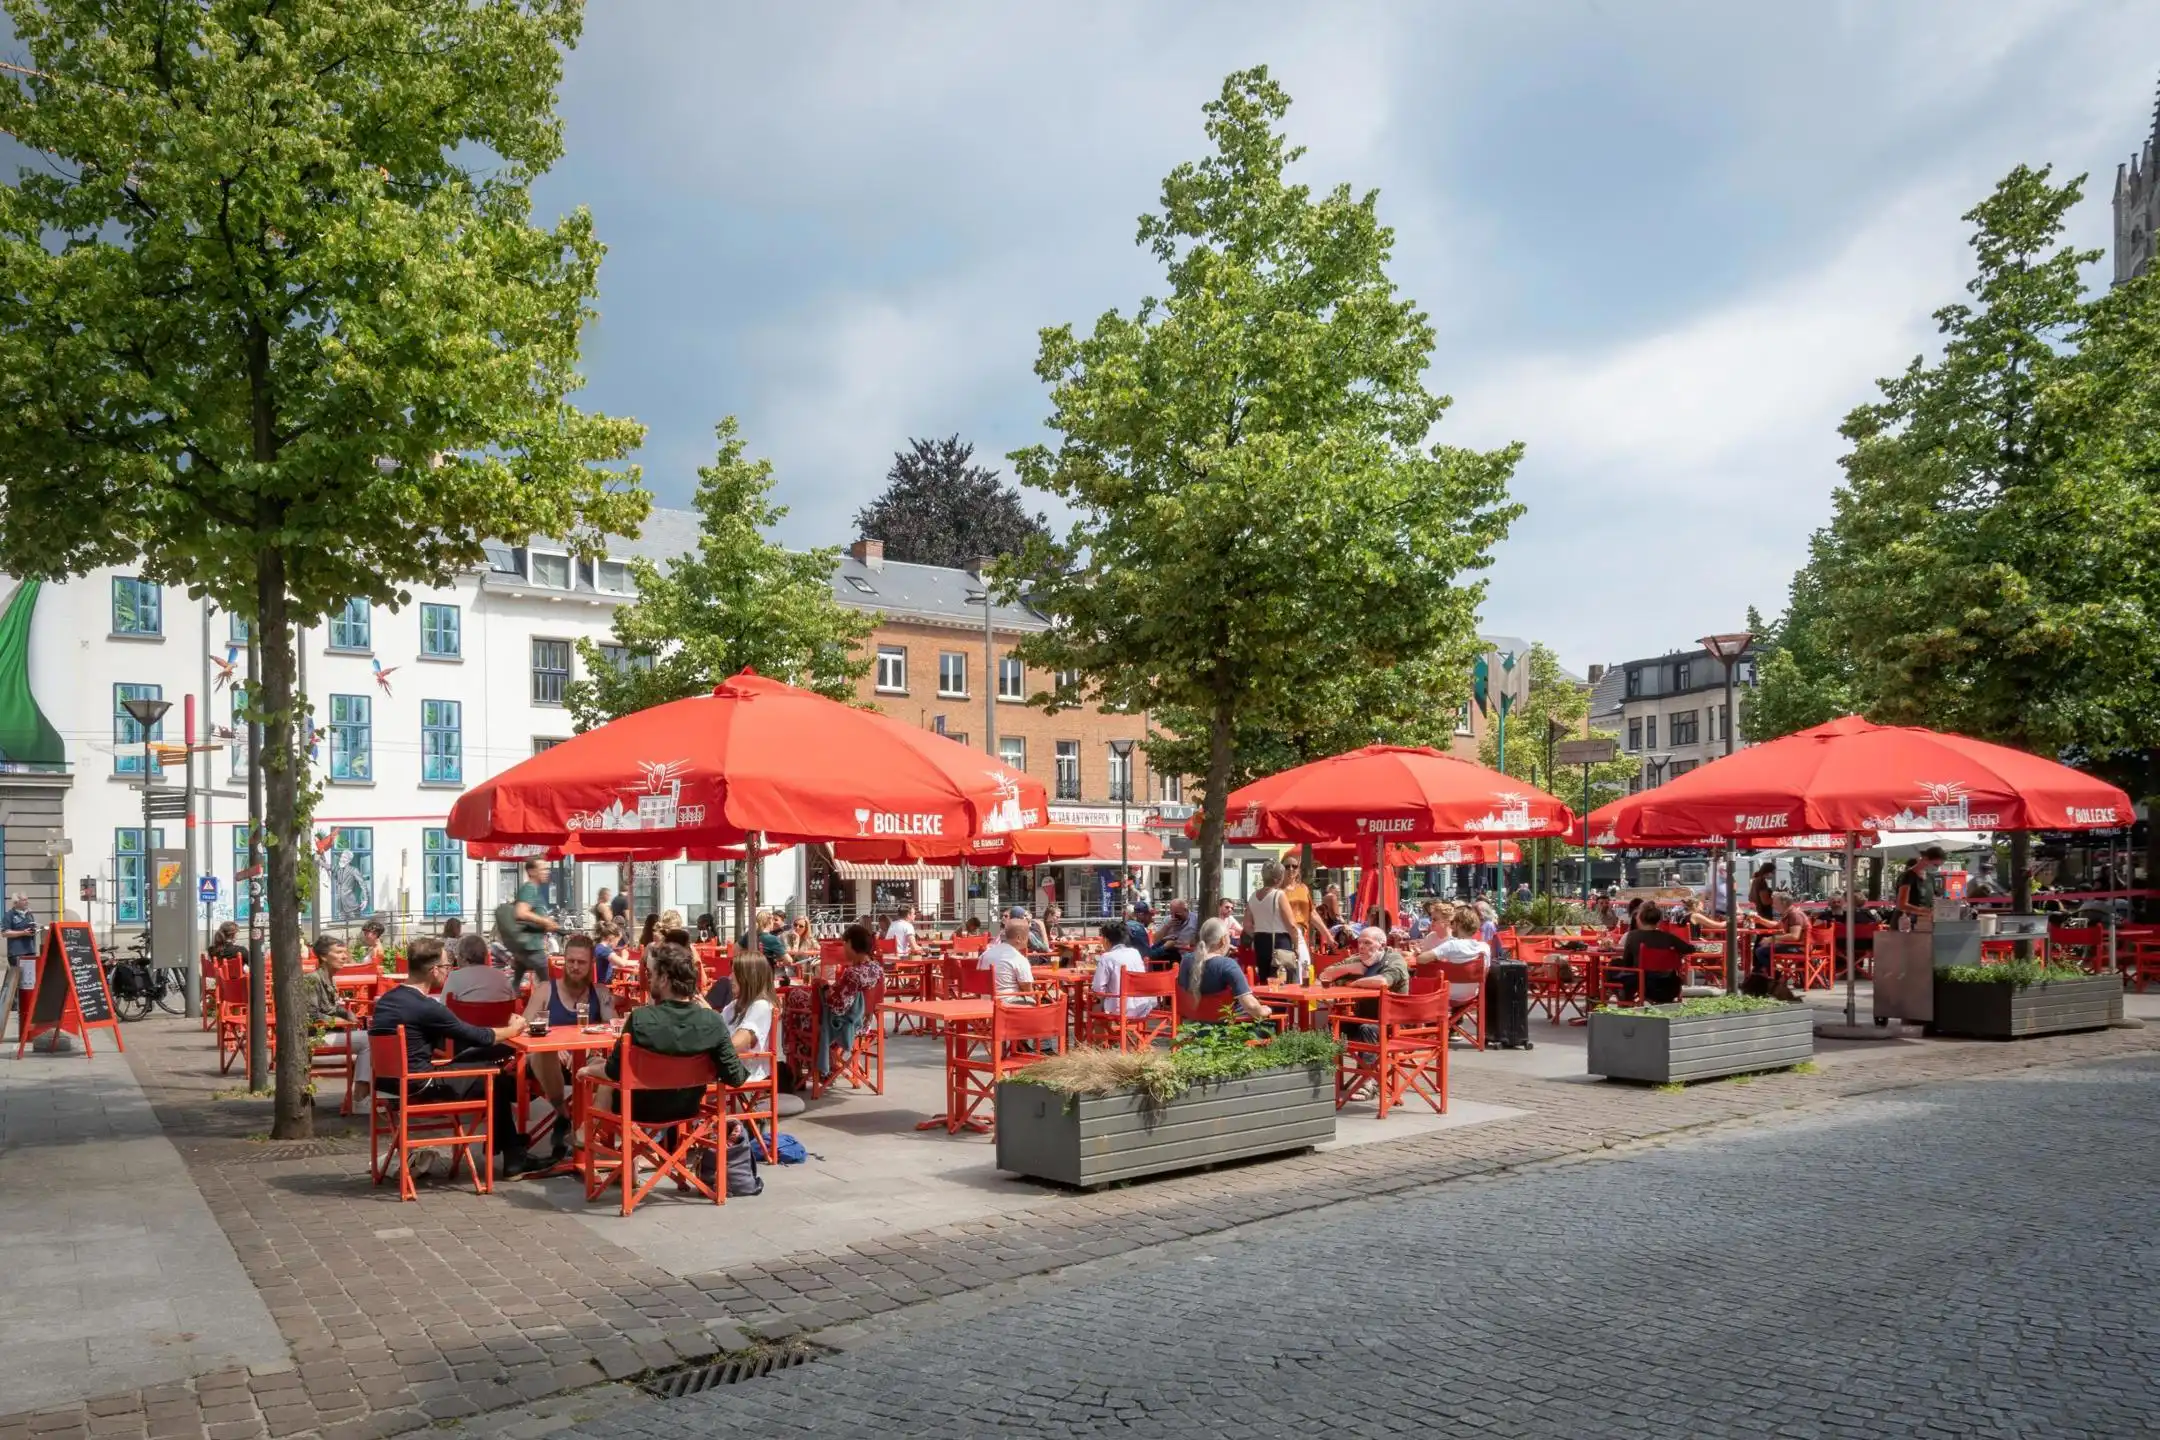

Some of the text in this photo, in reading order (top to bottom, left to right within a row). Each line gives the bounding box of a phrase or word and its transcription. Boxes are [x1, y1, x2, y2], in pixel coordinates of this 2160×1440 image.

[1745, 812, 1788, 830] BOLLEKE
[2075, 807, 2117, 823] BOLLEKE
[873, 812, 943, 836] BOLLEKE
[1369, 818, 1415, 832] BOLLEKE
